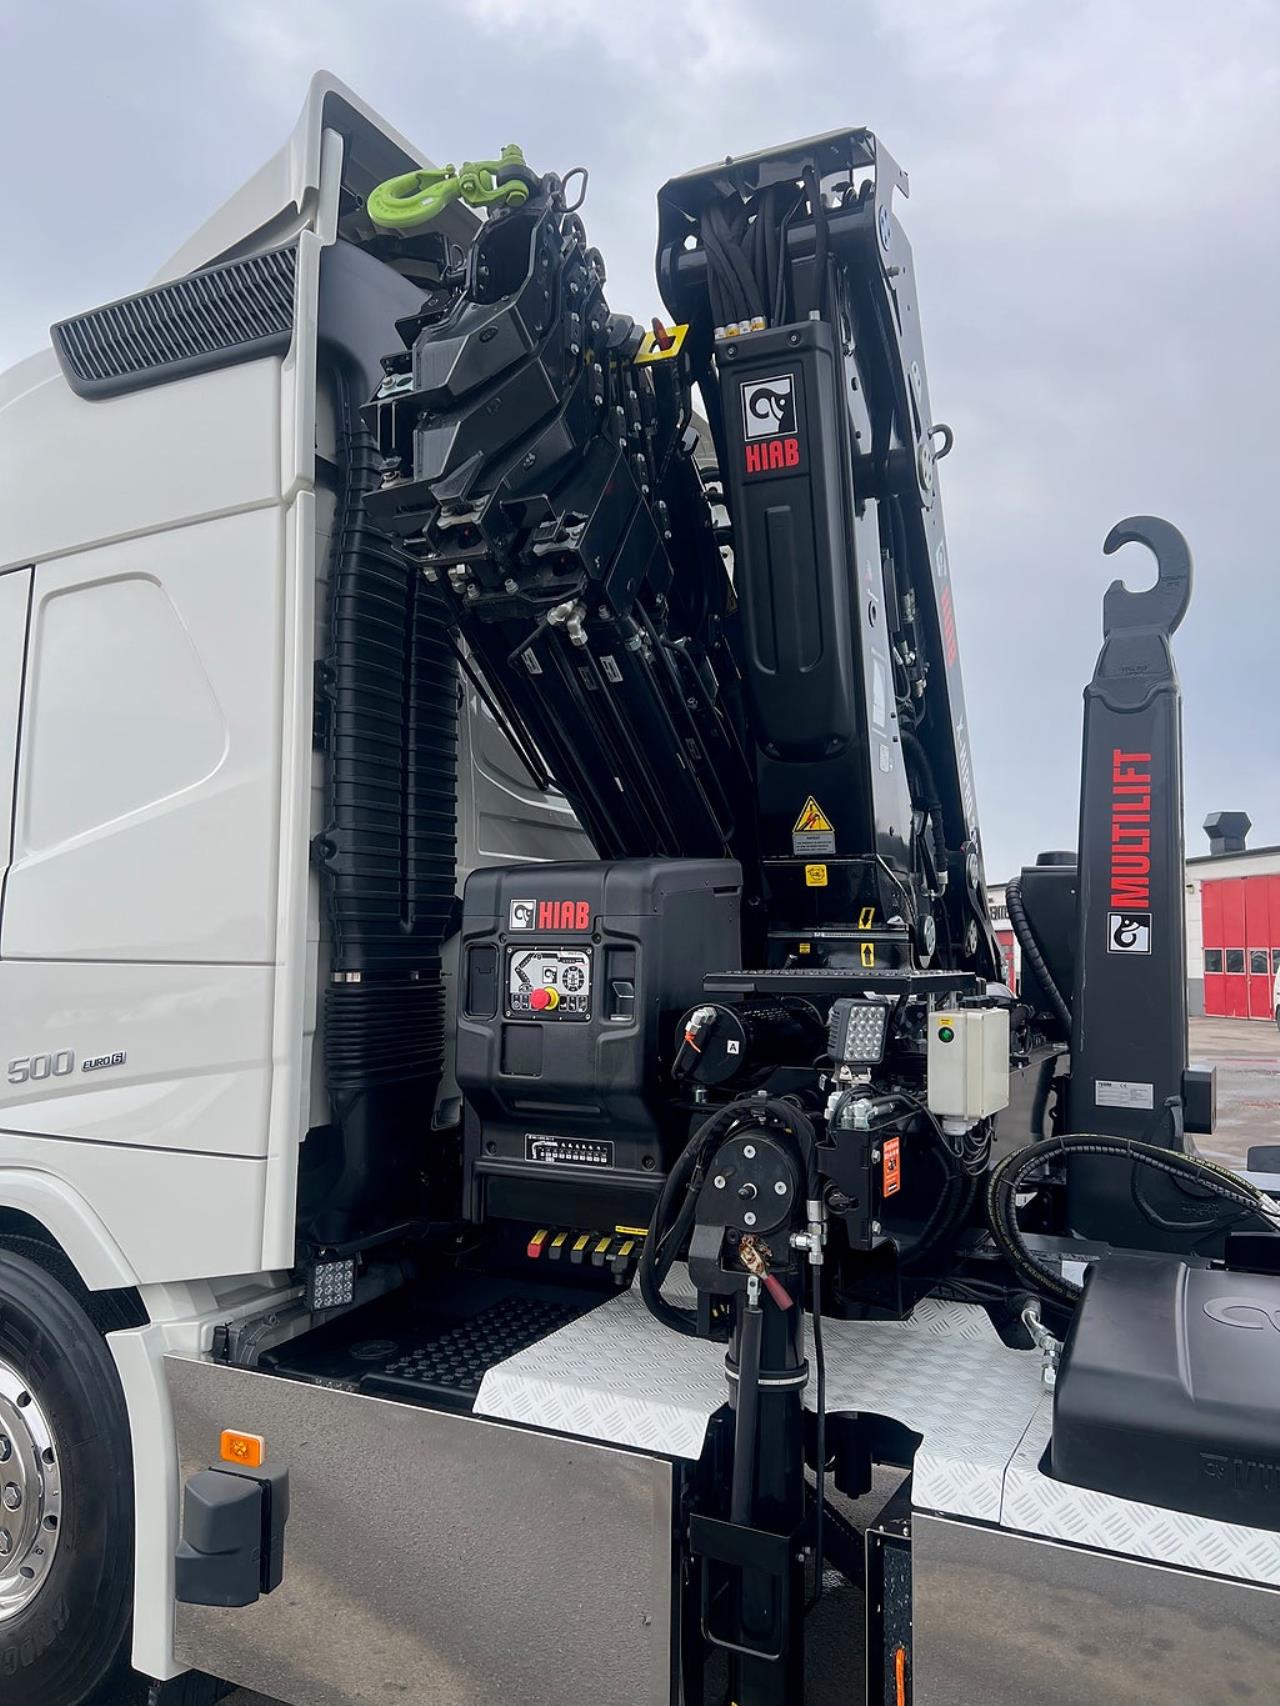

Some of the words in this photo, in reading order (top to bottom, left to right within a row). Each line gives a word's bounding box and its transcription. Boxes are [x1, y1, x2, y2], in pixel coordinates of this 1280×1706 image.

[745, 439, 800, 473] HIAB
[1110, 748, 1152, 909] MULTILIFT
[538, 901, 590, 929] HIAB
[729, 1042, 737, 1053] A
[7, 1049, 75, 1084] 500
